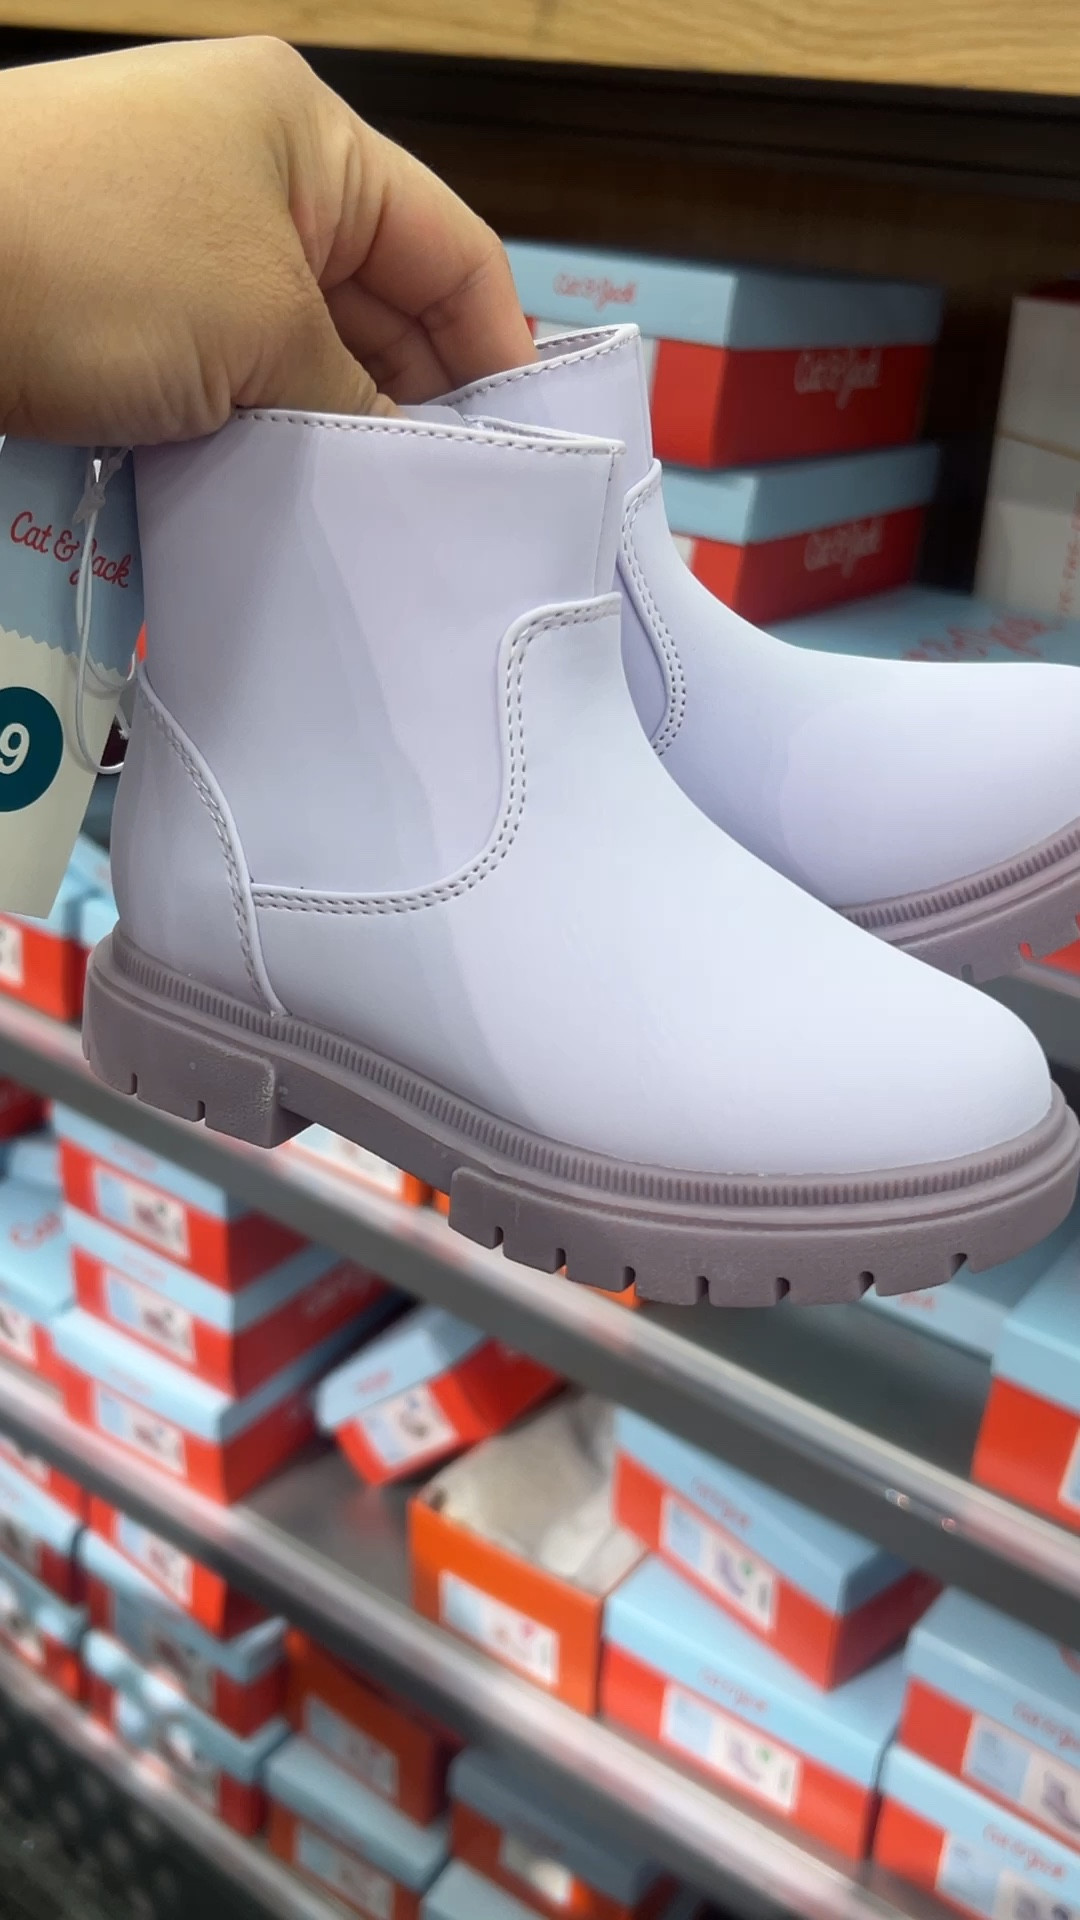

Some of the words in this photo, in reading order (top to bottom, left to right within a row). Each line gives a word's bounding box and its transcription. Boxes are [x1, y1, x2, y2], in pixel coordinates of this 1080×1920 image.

[10, 511, 51, 553] Cat
[53, 530, 79, 561] &
[0, 723, 29, 774] 9
